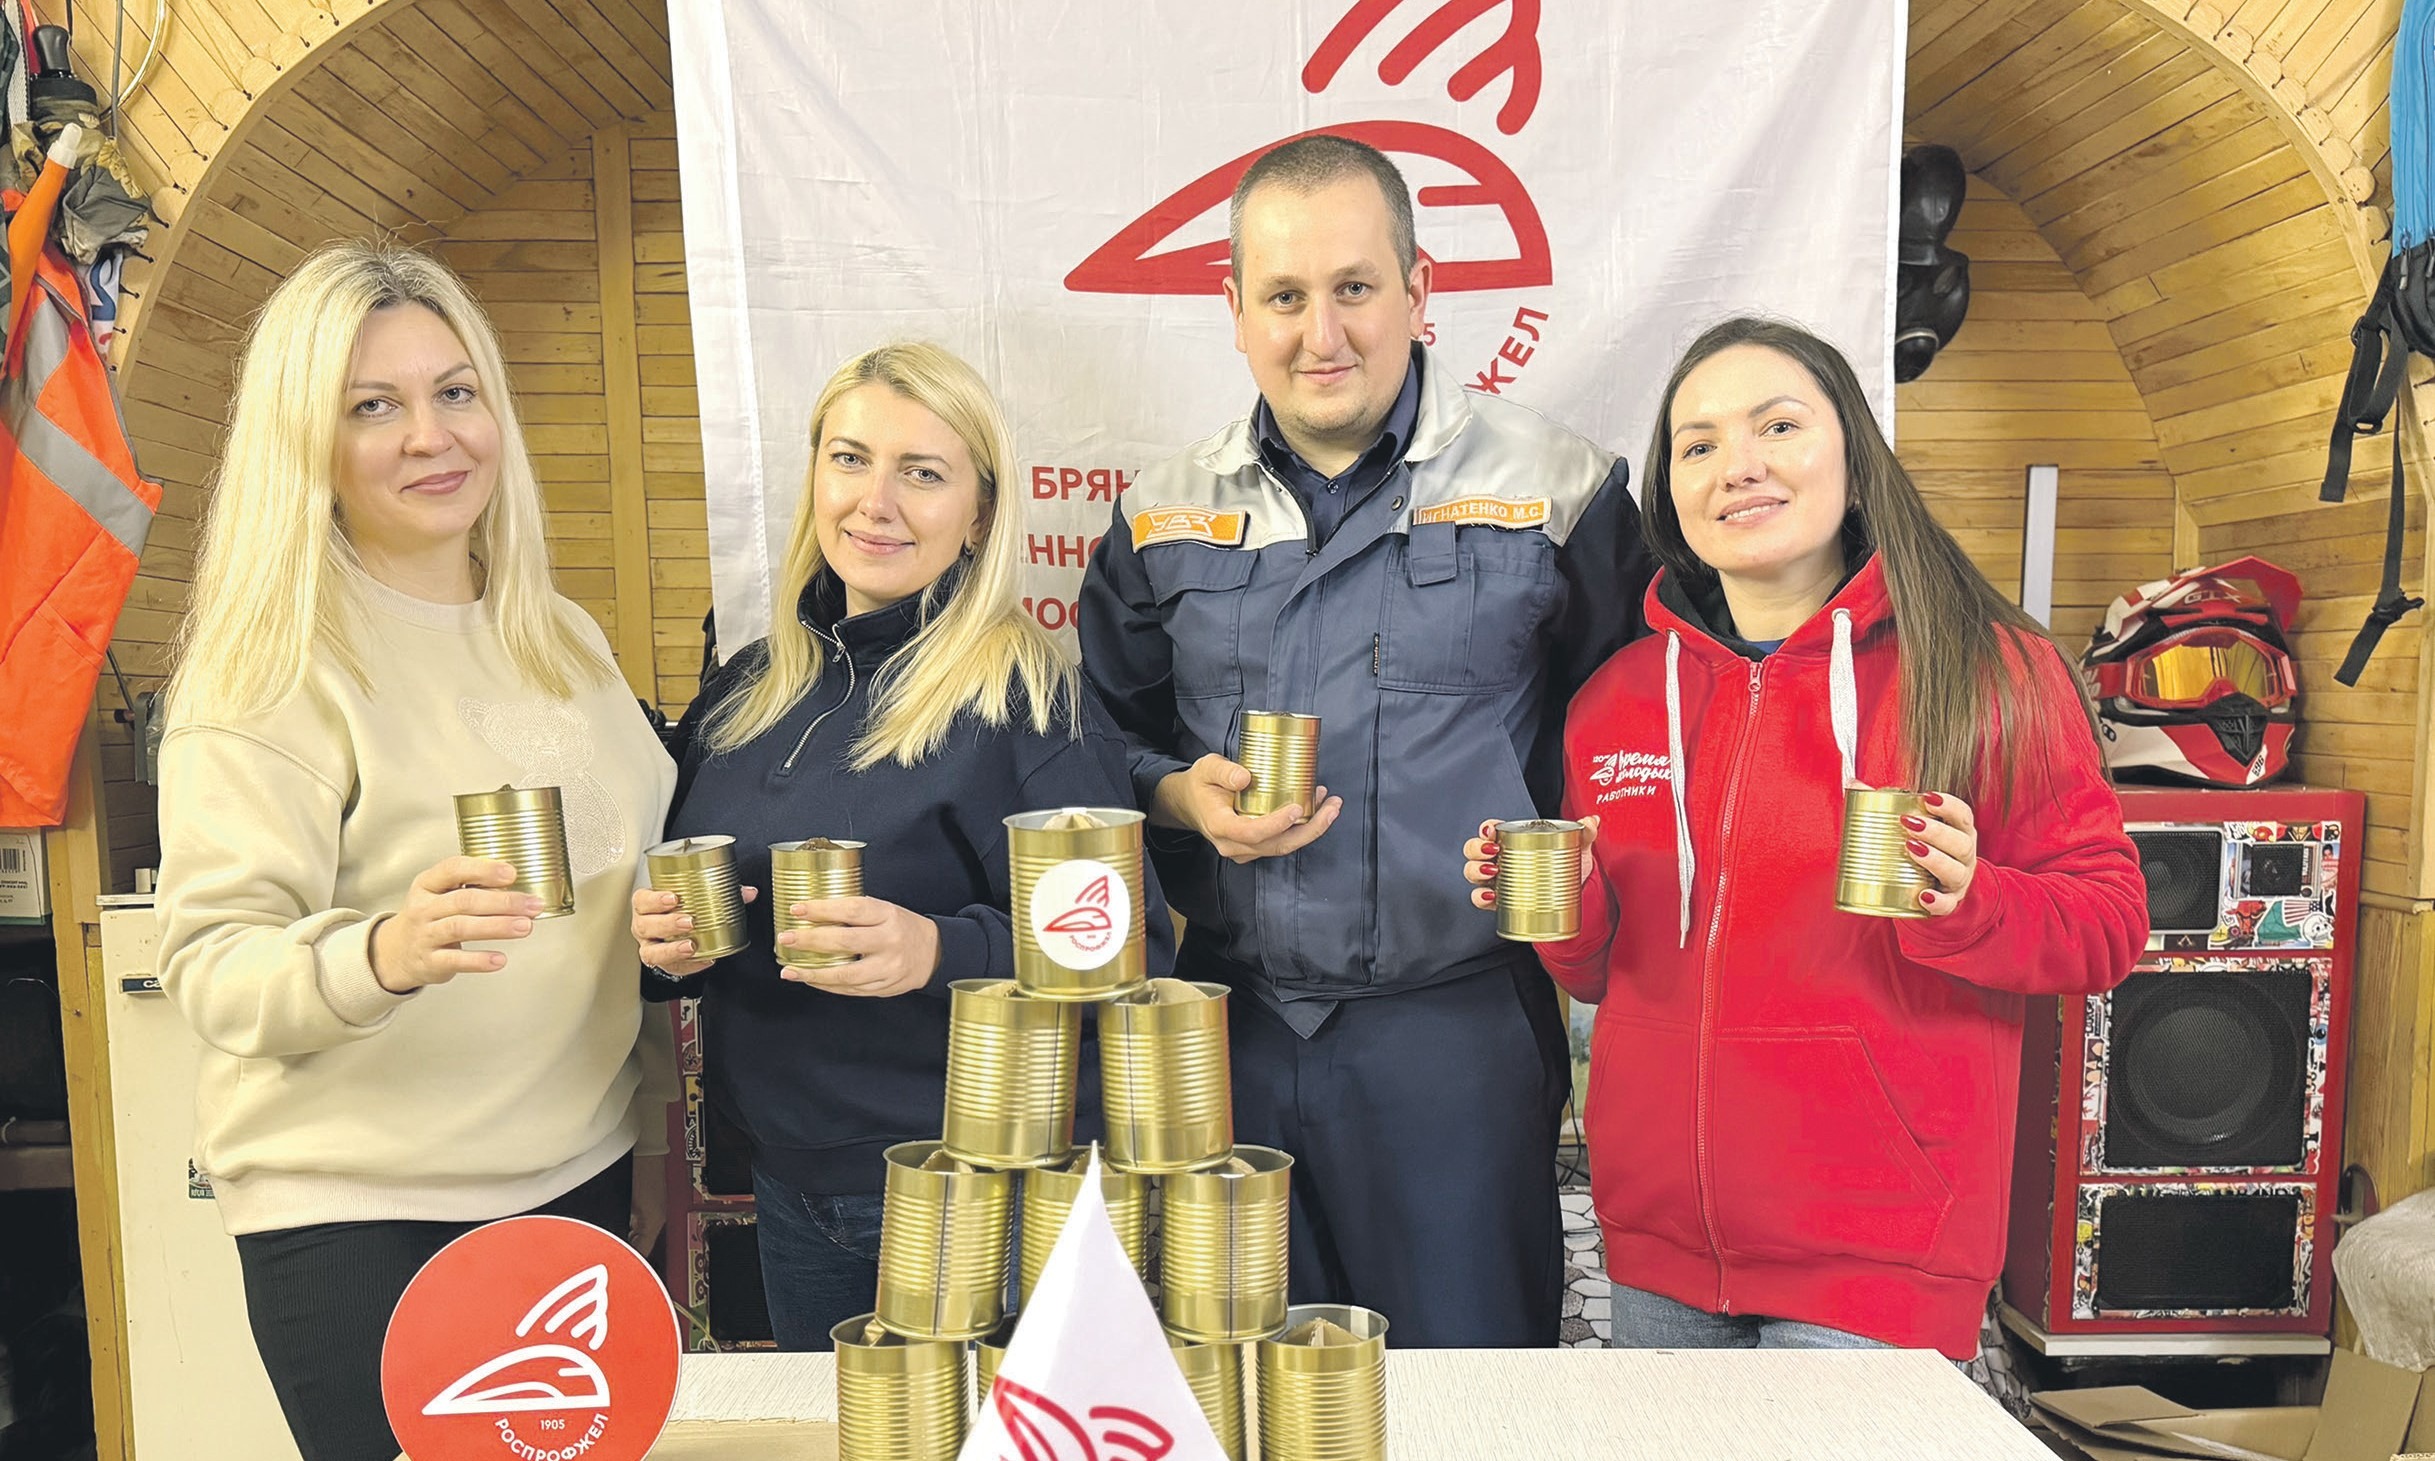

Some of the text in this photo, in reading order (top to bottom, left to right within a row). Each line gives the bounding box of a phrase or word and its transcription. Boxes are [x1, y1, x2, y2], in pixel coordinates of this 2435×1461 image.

[1595, 785, 1657, 805] РАБОТНИКИ
[540, 1419, 565, 1431] 1905
[494, 1412, 609, 1461] РОСПРОФЖЕЛ
